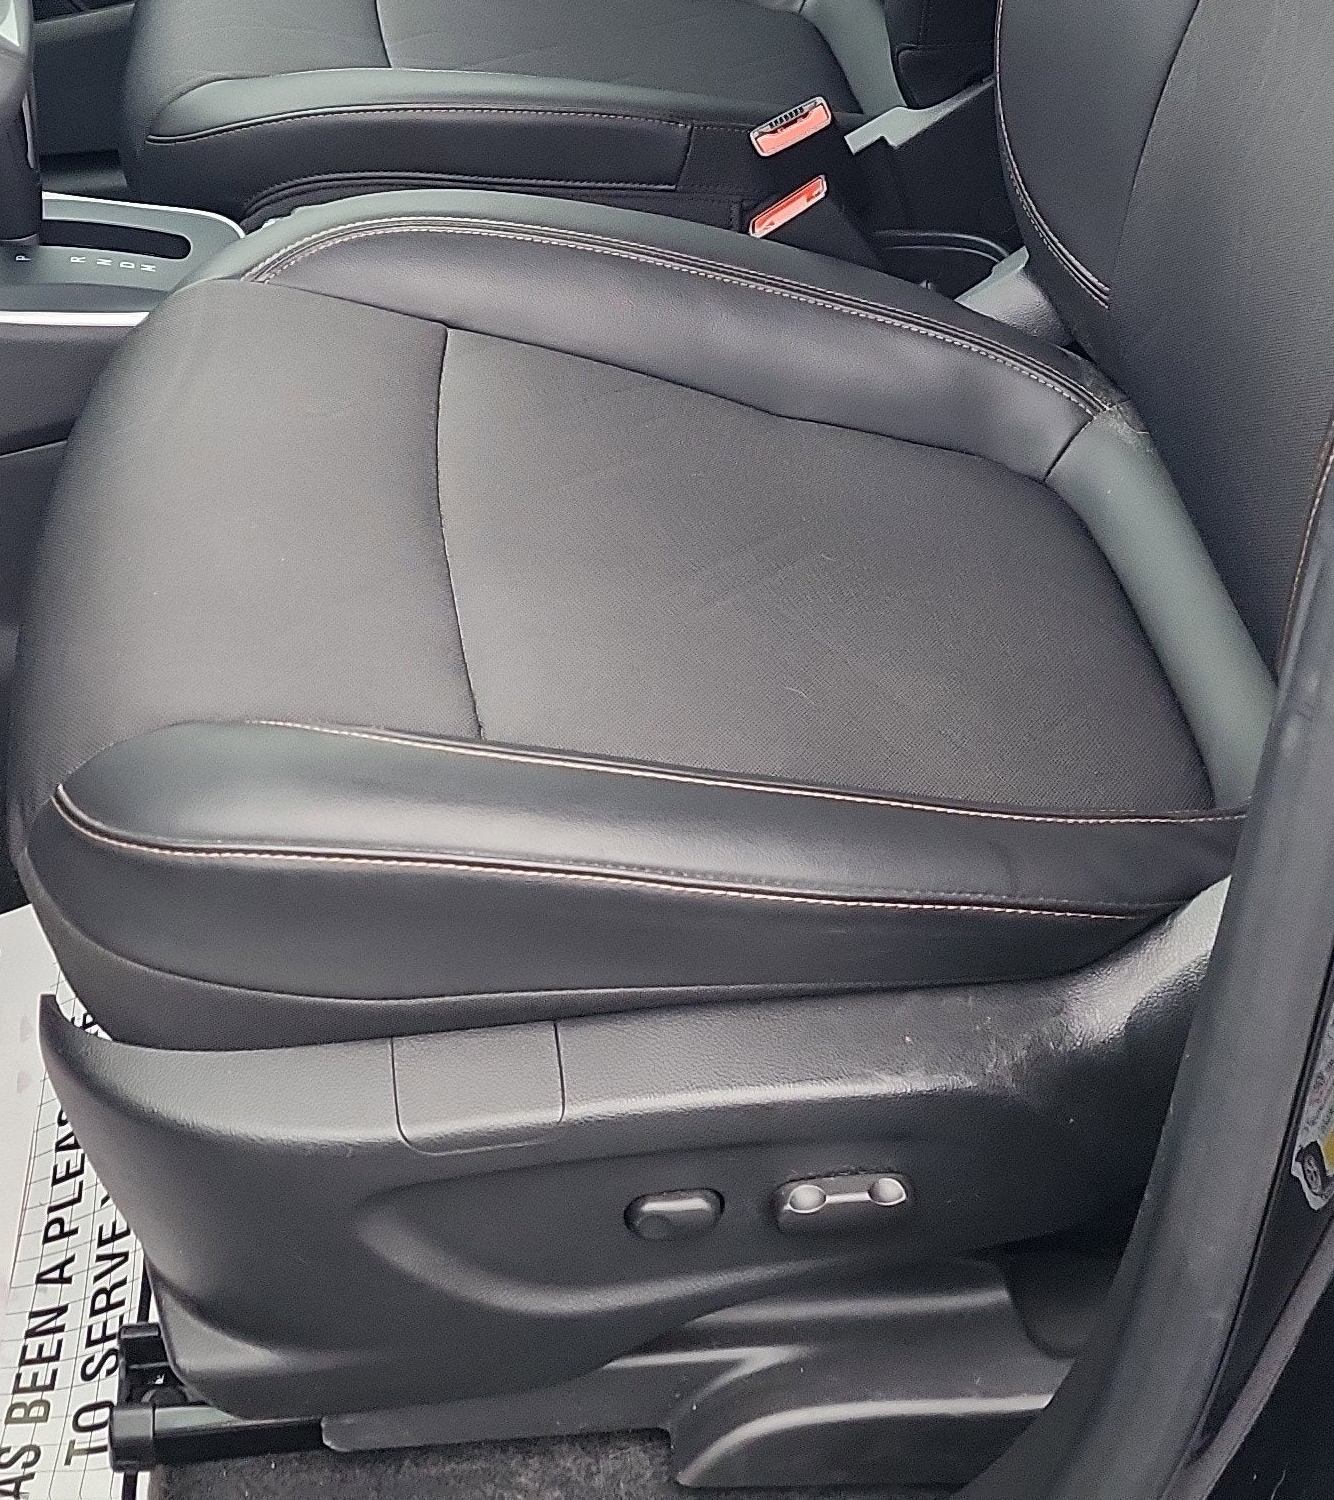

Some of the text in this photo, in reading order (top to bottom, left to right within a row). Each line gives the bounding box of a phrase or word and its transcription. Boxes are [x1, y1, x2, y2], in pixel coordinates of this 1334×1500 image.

[15, 254, 31, 262] P
[70, 256, 86, 264] R
[96, 258, 112, 266] N
[119, 261, 135, 269] D
[36, 1253, 75, 1286] A
[64, 1221, 130, 1466] TO SERVE
[4, 1304, 69, 1425] BEEN
